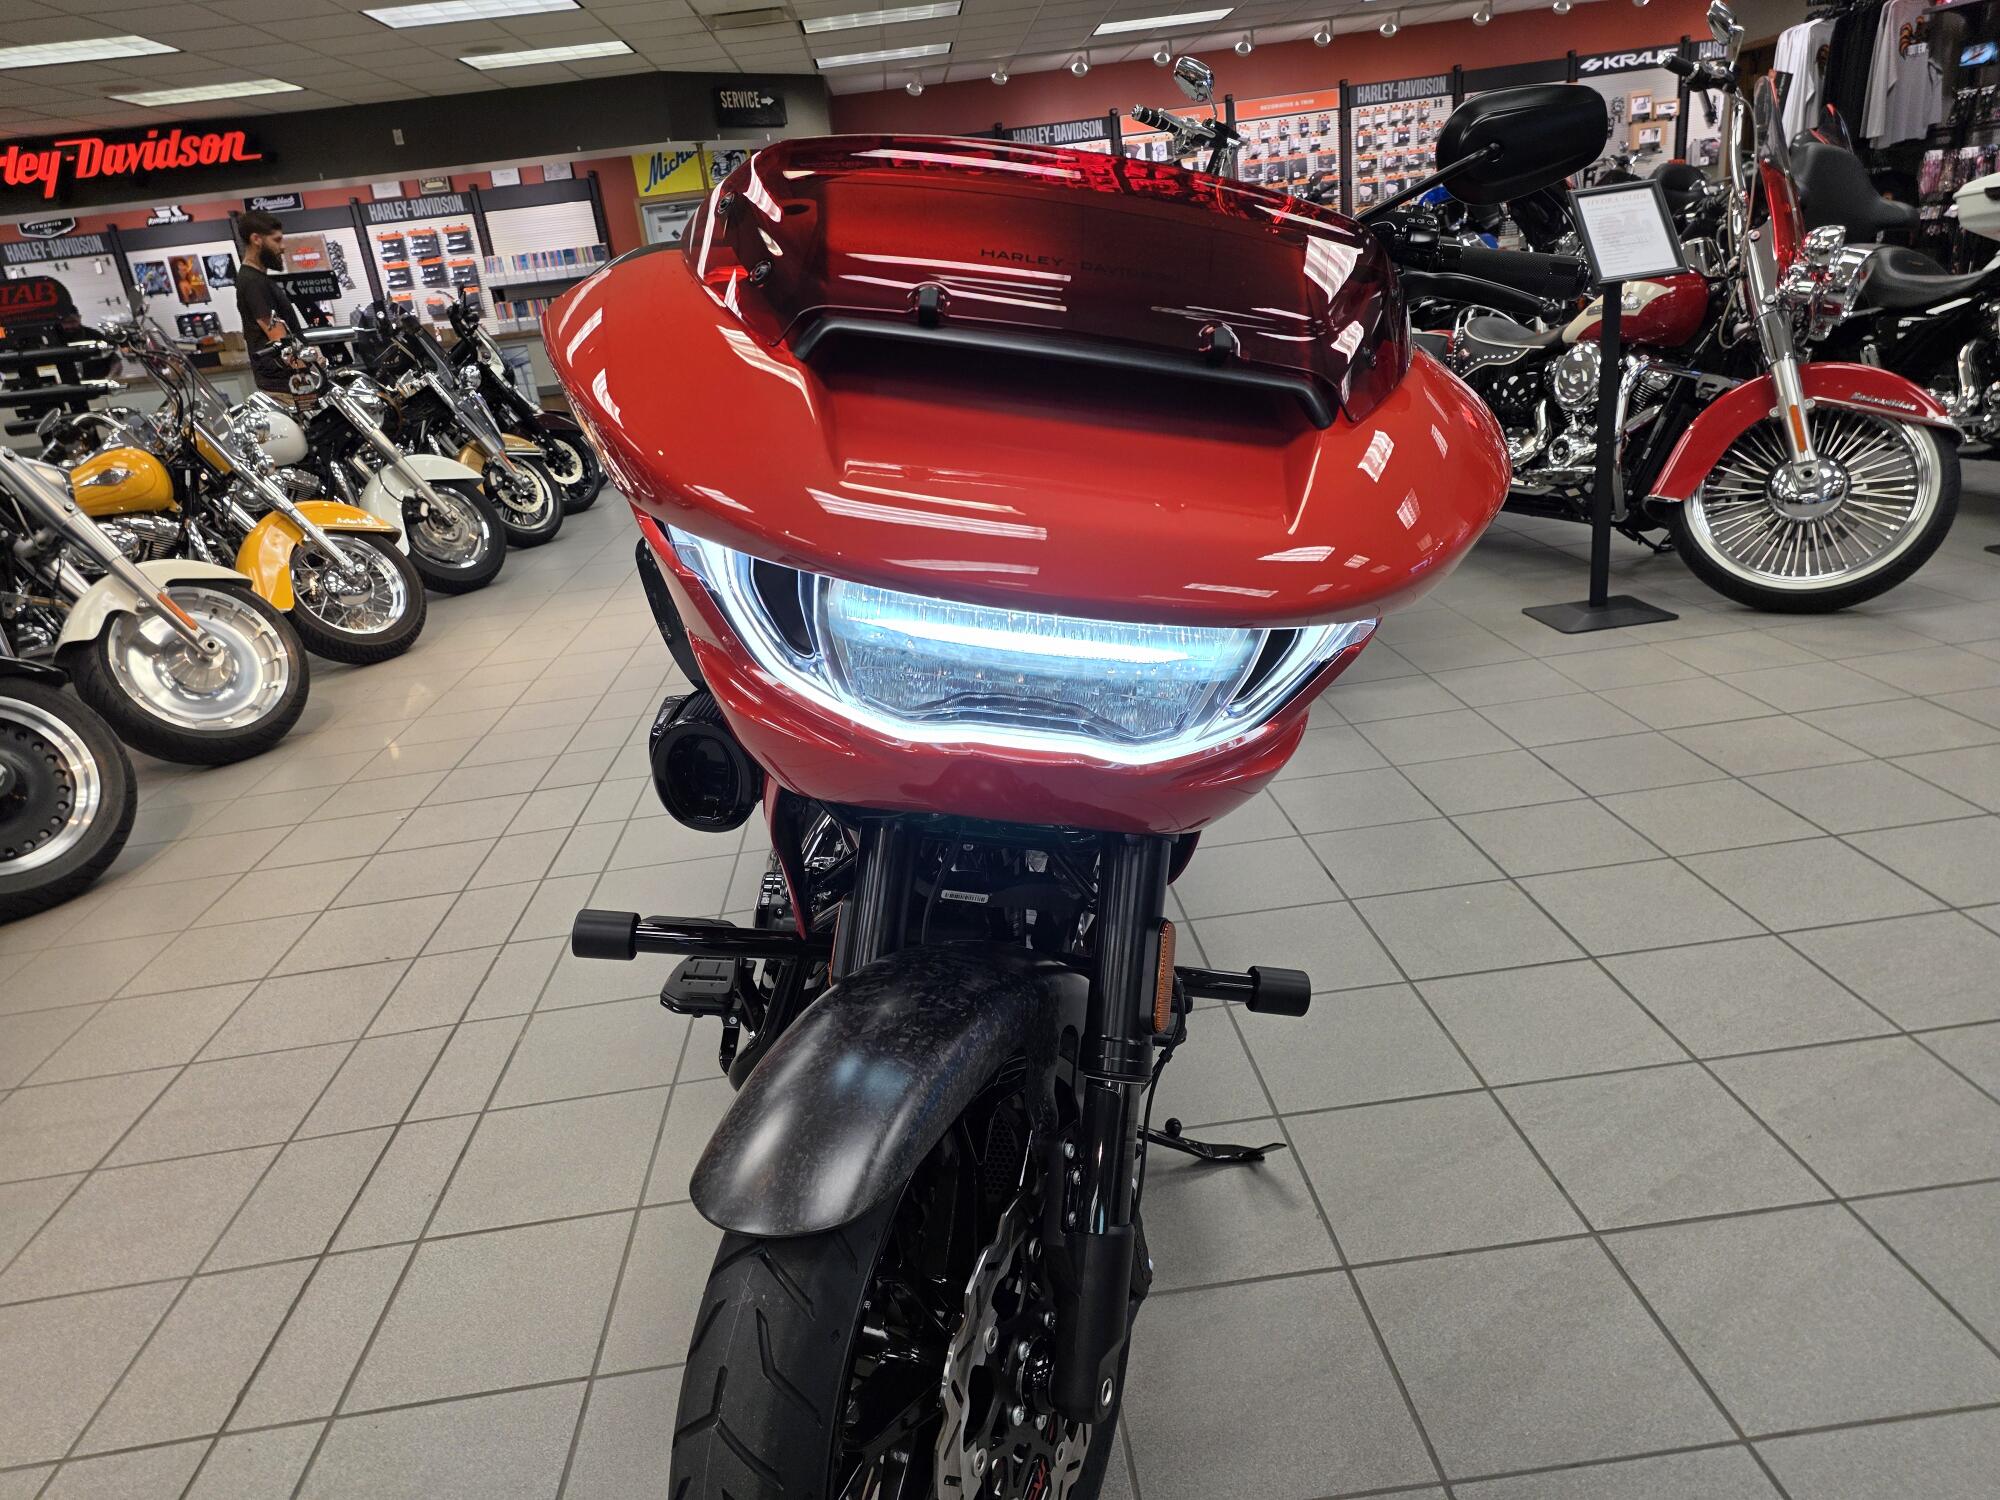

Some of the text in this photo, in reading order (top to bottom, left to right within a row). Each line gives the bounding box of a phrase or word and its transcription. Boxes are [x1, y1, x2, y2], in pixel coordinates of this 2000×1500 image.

[1604, 47, 1678, 70] KRAU
[720, 91, 761, 109] SERVICE
[1357, 75, 1447, 104] HARLEY-DAVIDSON
[1012, 119, 1103, 144] HARLEY-DAVIDSON
[367, 194, 465, 222] HARLEY-DAVIDSON
[4, 235, 104, 262] HARLEY-DAVIDSON
[296, 278, 332, 287] KHROME
[298, 285, 334, 295] WERKS
